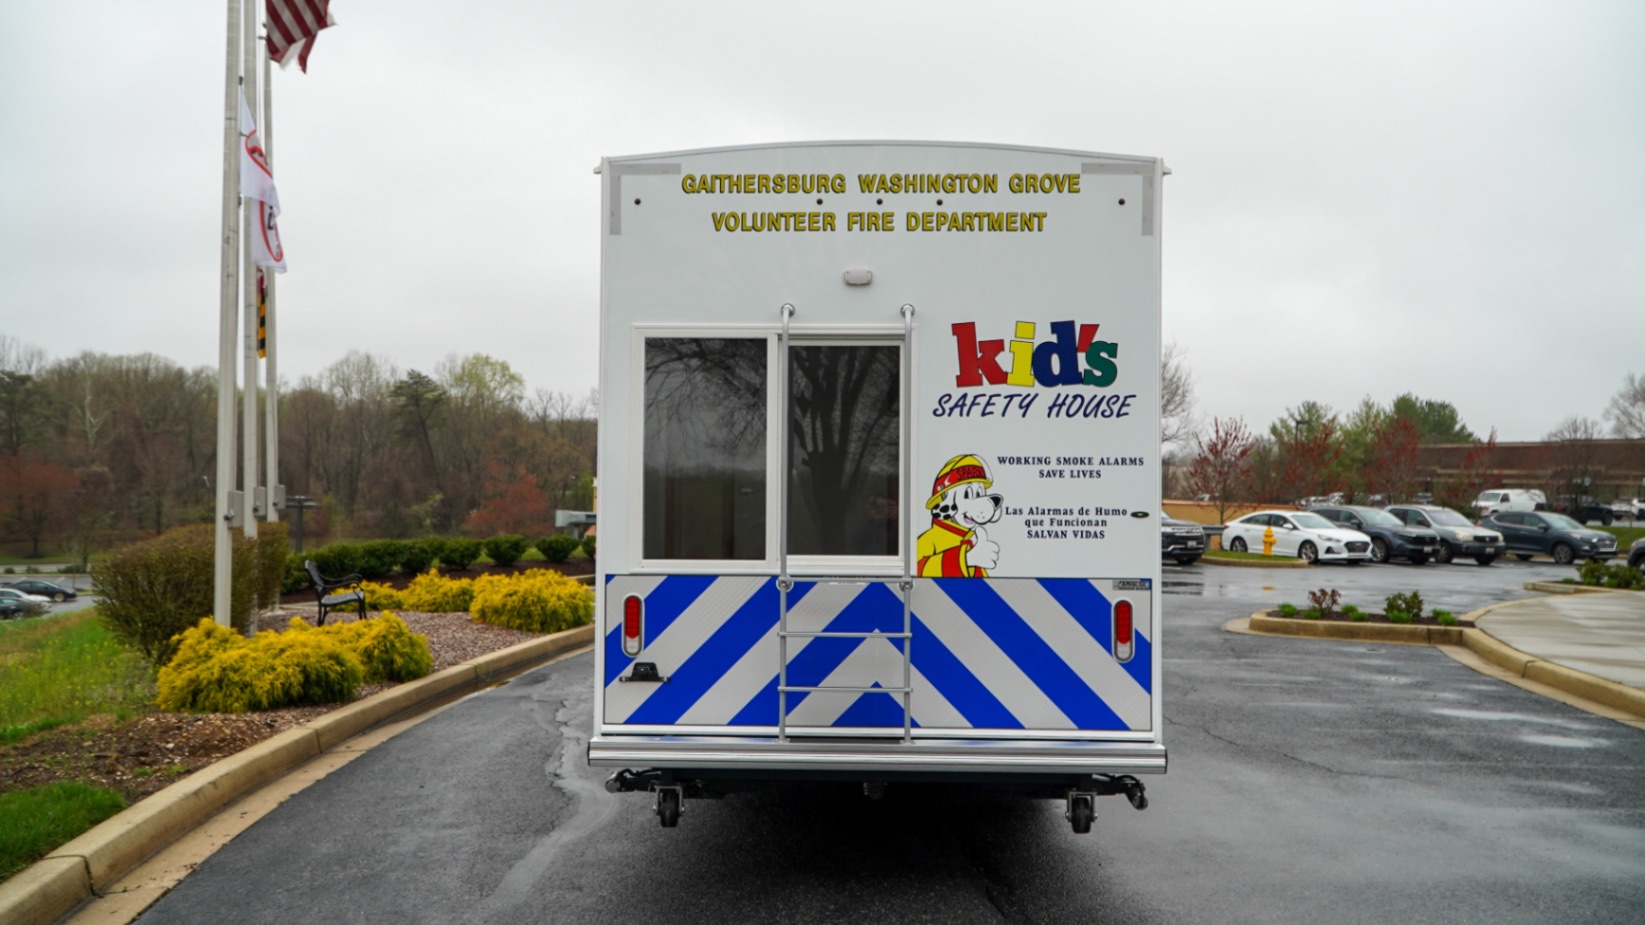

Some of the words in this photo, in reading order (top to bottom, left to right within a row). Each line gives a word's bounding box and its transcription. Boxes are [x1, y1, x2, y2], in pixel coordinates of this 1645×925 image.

[682, 173, 846, 194] GAITHERSBURG
[858, 173, 998, 194] WASHINGTON
[1009, 173, 1081, 194] GROVE
[711, 211, 836, 232] VOLUNTEER
[847, 212, 895, 232] FIRE
[906, 212, 1047, 232] DEPARTMENT
[951, 320, 1118, 388] kid's
[932, 393, 1039, 418] SAFETY
[1047, 393, 1136, 418] HOUSE
[997, 456, 1051, 466] WORKING
[1056, 456, 1094, 466] SMOKE
[1099, 456, 1145, 466] ALARMS
[1039, 469, 1065, 479] SAVE
[1070, 469, 1102, 479] LIVES
[1005, 506, 1023, 516] Las
[1028, 506, 1074, 516] Alarmas
[1078, 506, 1090, 516] de
[1095, 506, 1128, 516] Humo
[1025, 519, 1045, 528] que
[1050, 517, 1108, 528] Funcionan
[1027, 530, 1068, 540] SALVAN
[1072, 530, 1106, 540] VIDAS
